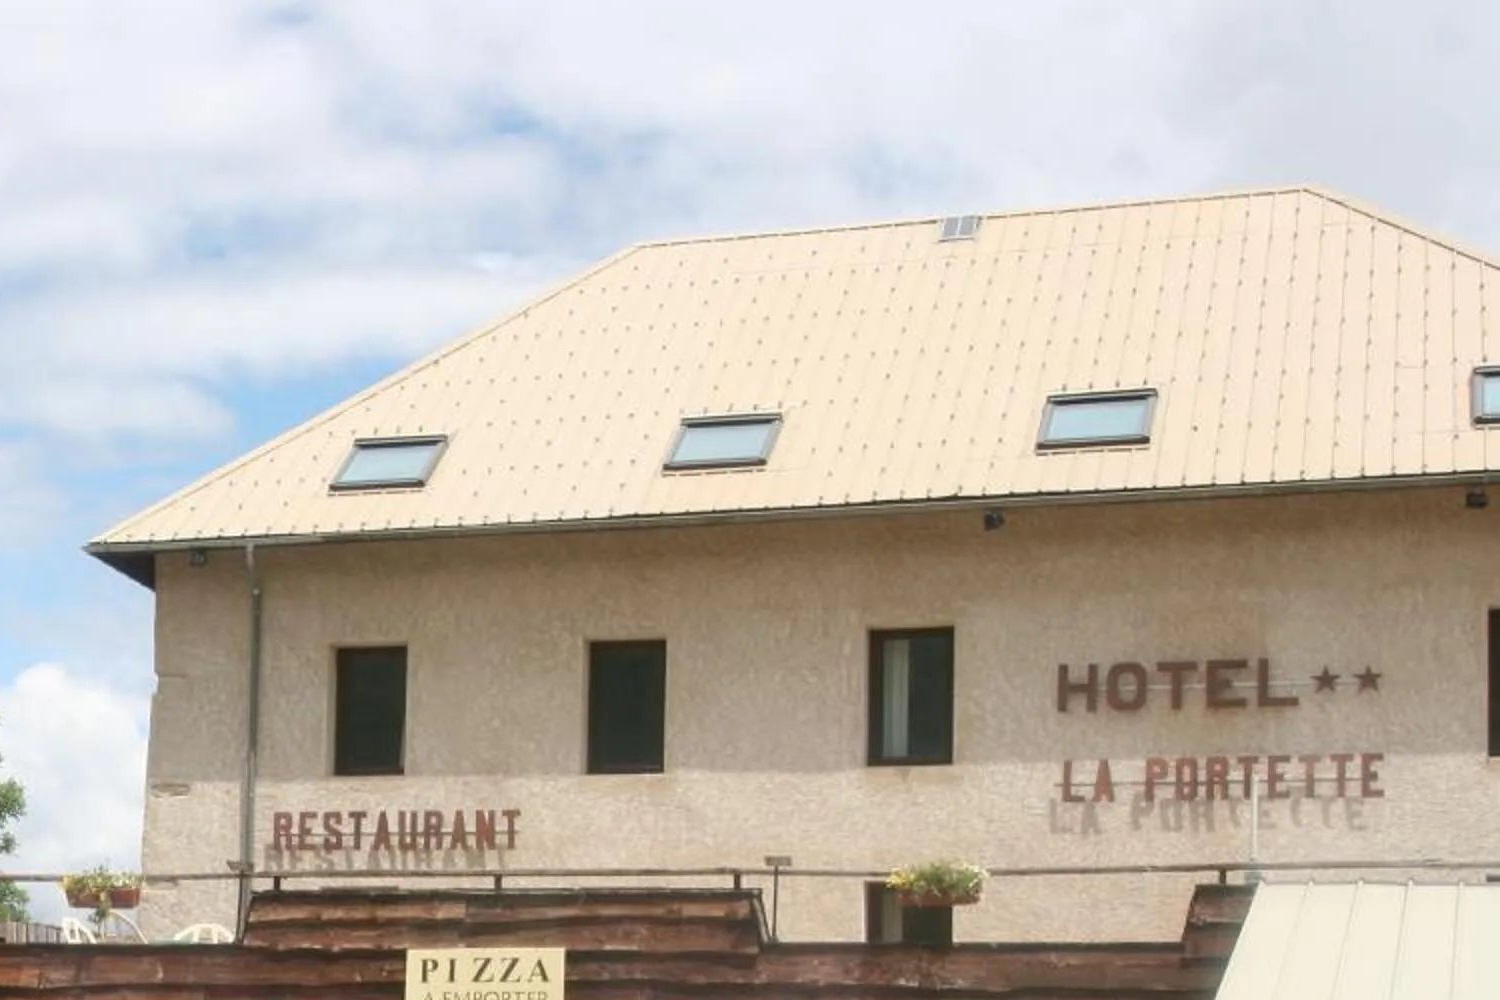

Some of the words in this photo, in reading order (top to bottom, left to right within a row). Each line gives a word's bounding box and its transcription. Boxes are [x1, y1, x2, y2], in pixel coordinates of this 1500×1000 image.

[1057, 658, 1299, 712] HOTEL
[1062, 759, 1114, 802] LA
[1145, 753, 1385, 802] PORTETTE
[273, 808, 521, 852] RESTAURANT
[420, 957, 550, 984] PIZZA
